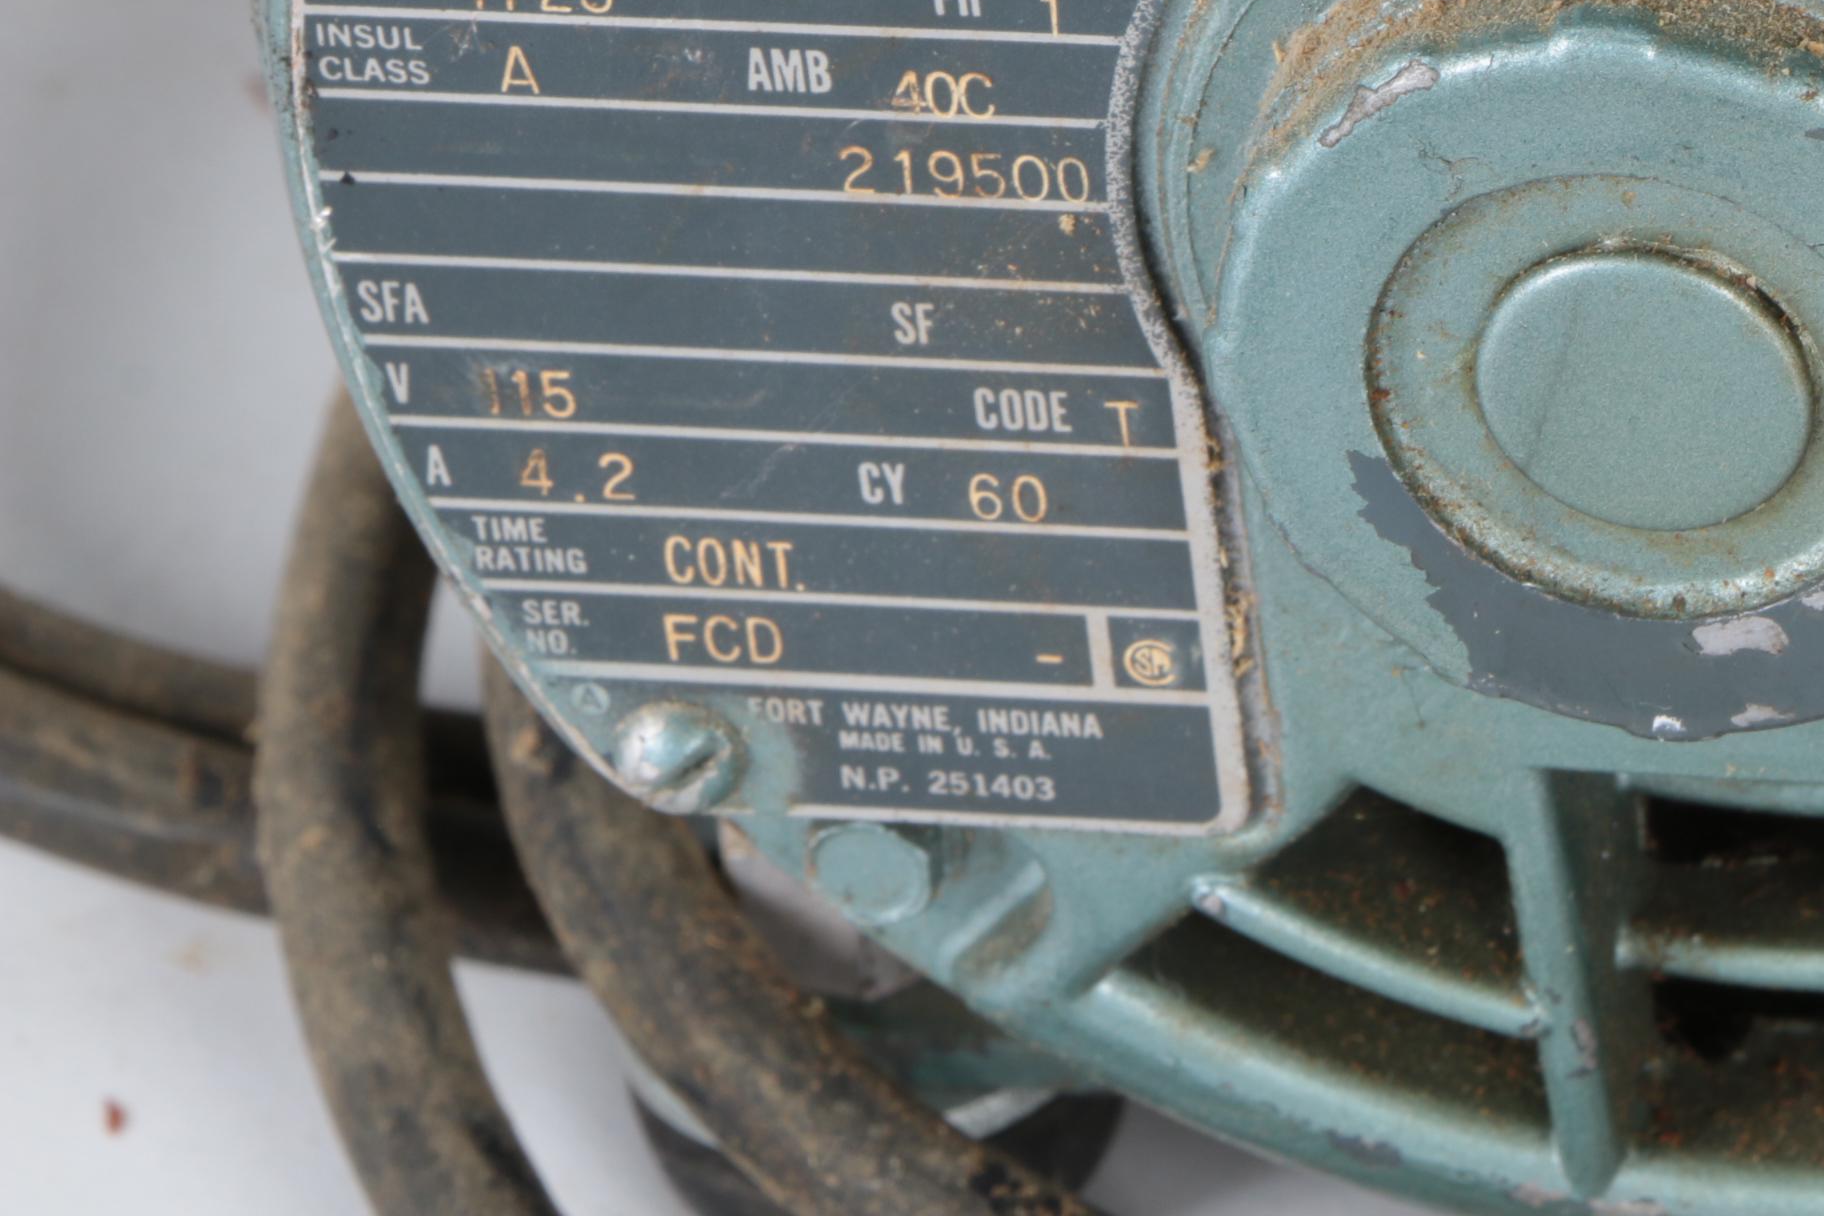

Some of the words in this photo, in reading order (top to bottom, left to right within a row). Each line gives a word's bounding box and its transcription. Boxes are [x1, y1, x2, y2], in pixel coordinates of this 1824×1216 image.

[315, 22, 423, 52] INSUL
[318, 56, 431, 87] CLASS
[501, 45, 540, 95] A
[747, 47, 832, 94] AMB
[838, 145, 1090, 203] 219500
[357, 280, 429, 326] SFA
[891, 303, 935, 346] SF
[385, 362, 410, 405] V
[480, 368, 578, 419] 115
[973, 387, 1073, 433] CODE
[1104, 401, 1139, 449] T
[427, 444, 452, 487] A
[520, 448, 637, 503] 4.2
[858, 461, 906, 506] CY
[967, 473, 1049, 524] 60
[472, 515, 546, 544] TIME
[475, 544, 588, 575] RATING
[664, 534, 805, 592] CONT.
[521, 598, 590, 627] SER.
[525, 629, 577, 656] NO.
[662, 612, 784, 665] FCD
[748, 696, 824, 726] FORT
[841, 700, 963, 735] WAYNE,
[976, 708, 1104, 740] INDIANA
[838, 729, 905, 754] MADE
[917, 734, 944, 755] IN
[839, 764, 911, 794] N.P.
[927, 769, 1057, 802] 251403
